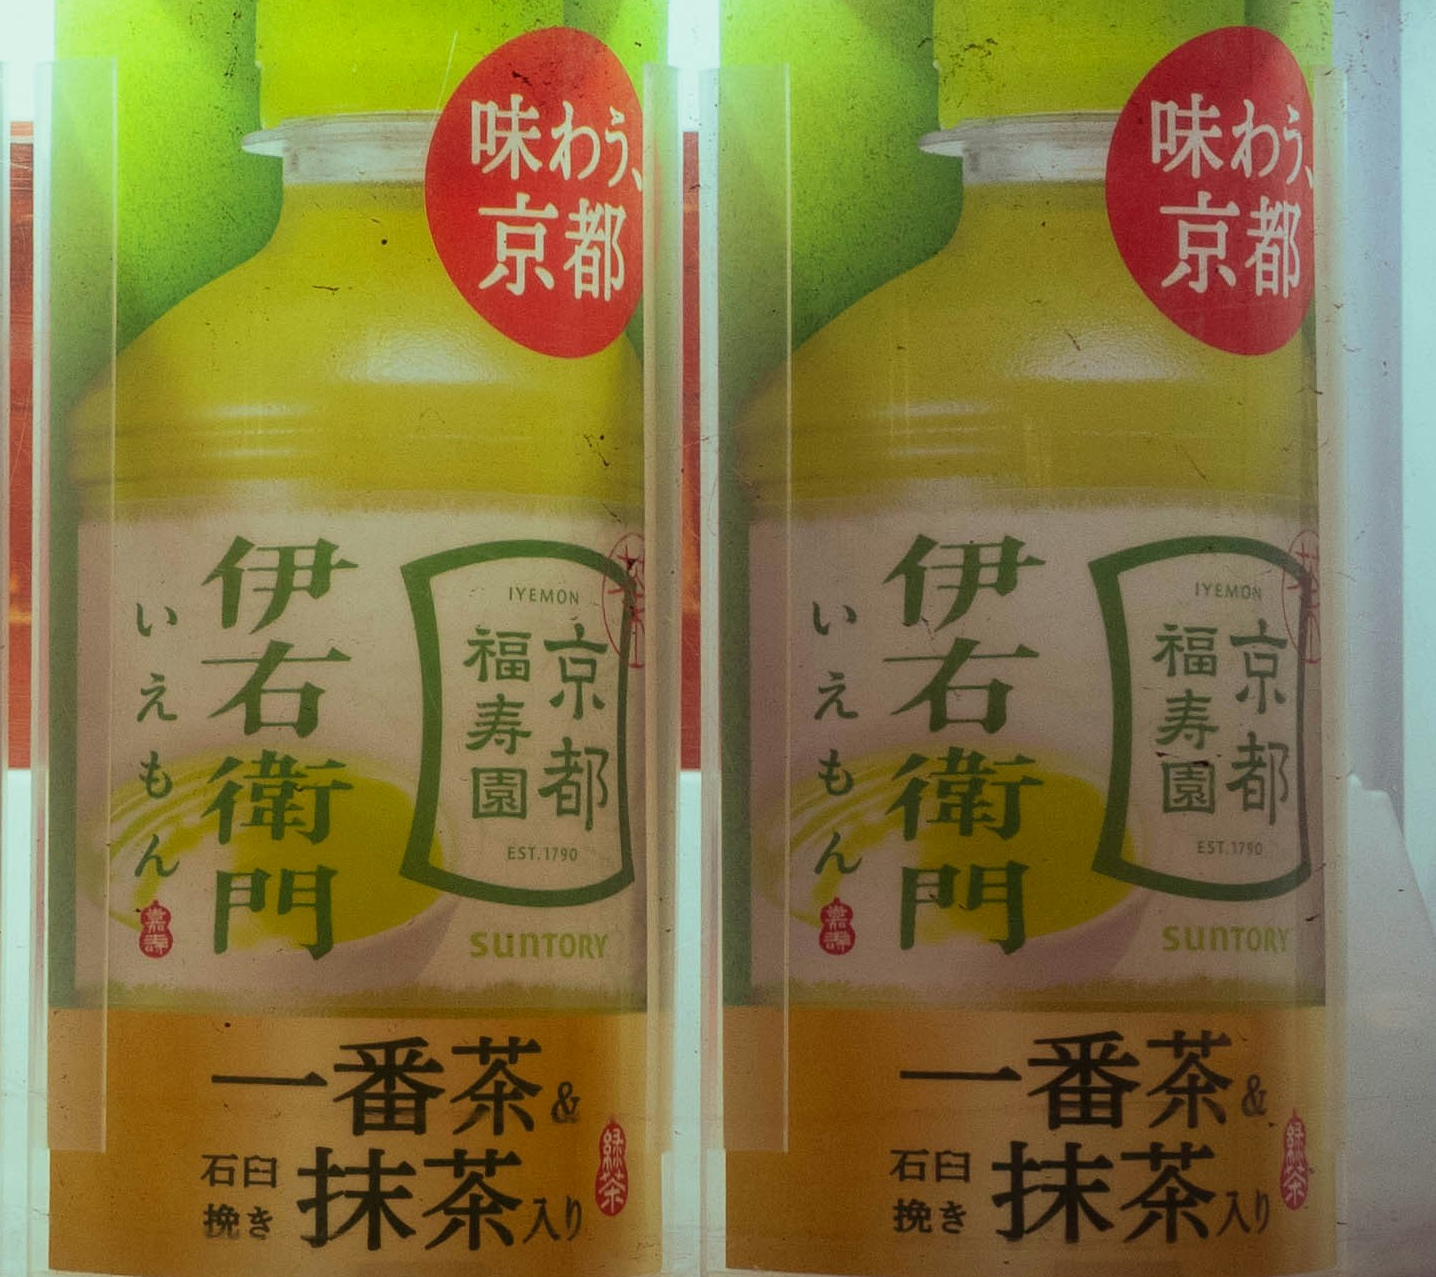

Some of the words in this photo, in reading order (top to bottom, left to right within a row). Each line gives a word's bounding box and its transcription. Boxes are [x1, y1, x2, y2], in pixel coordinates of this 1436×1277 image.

[478, 193, 627, 302] 京都
[1159, 191, 1302, 299] 京都
[508, 586, 580, 606] IYEMON
[1195, 582, 1263, 601] IYEMON
[134, 602, 180, 880] いえもん
[201, 535, 359, 960] 伊右衛門
[462, 625, 533, 820] 福寿園
[538, 623, 610, 832] 京都
[812, 601, 863, 876] いえもん
[882, 534, 1046, 955] 伊右衛門
[1152, 622, 1218, 815] 福寿園
[1226, 619, 1289, 825] 京都
[469, 931, 608, 958] SUNTORY
[1162, 926, 1289, 952] SUNTORY
[201, 1154, 277, 1189] 石臼
[890, 1148, 971, 1184] 石臼
[894, 1198, 968, 1235] 挽き
[203, 1203, 274, 1241] 挽き
